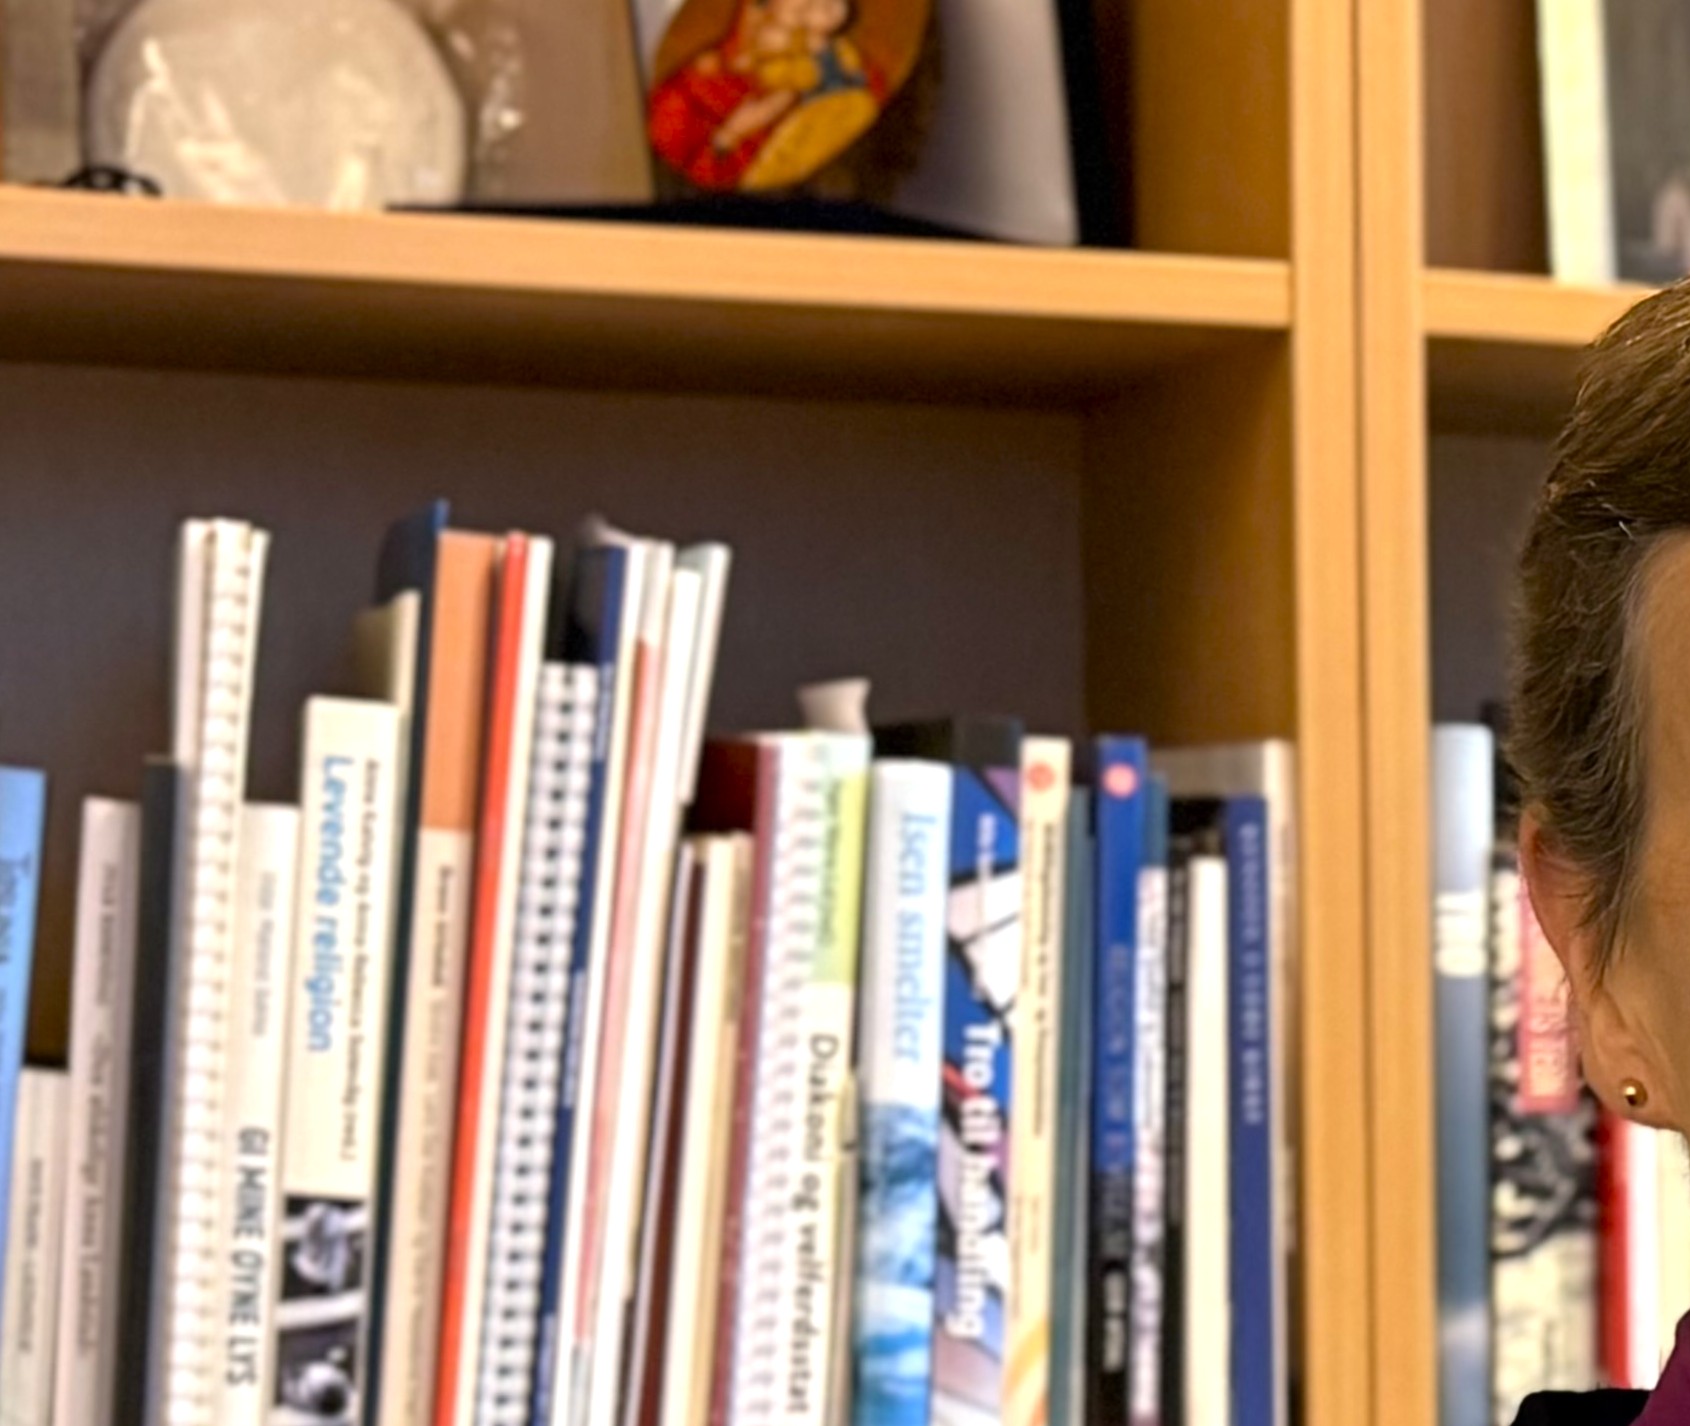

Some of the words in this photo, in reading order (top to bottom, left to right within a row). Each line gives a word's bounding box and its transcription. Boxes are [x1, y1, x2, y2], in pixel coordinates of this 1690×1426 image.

[317, 755, 353, 905] Levende
[898, 812, 936, 896] Isen
[305, 917, 343, 1052] religion
[894, 911, 932, 1060] smelter
[805, 1034, 838, 1161] Diakoni
[963, 1023, 1001, 1088] Tro
[957, 1097, 999, 1152] til
[233, 1166, 264, 1237] MINE
[791, 1174, 819, 1211] og
[949, 1154, 999, 1339] handling
[224, 1336, 257, 1386] LYS
[789, 1225, 821, 1412] velferdsstat
